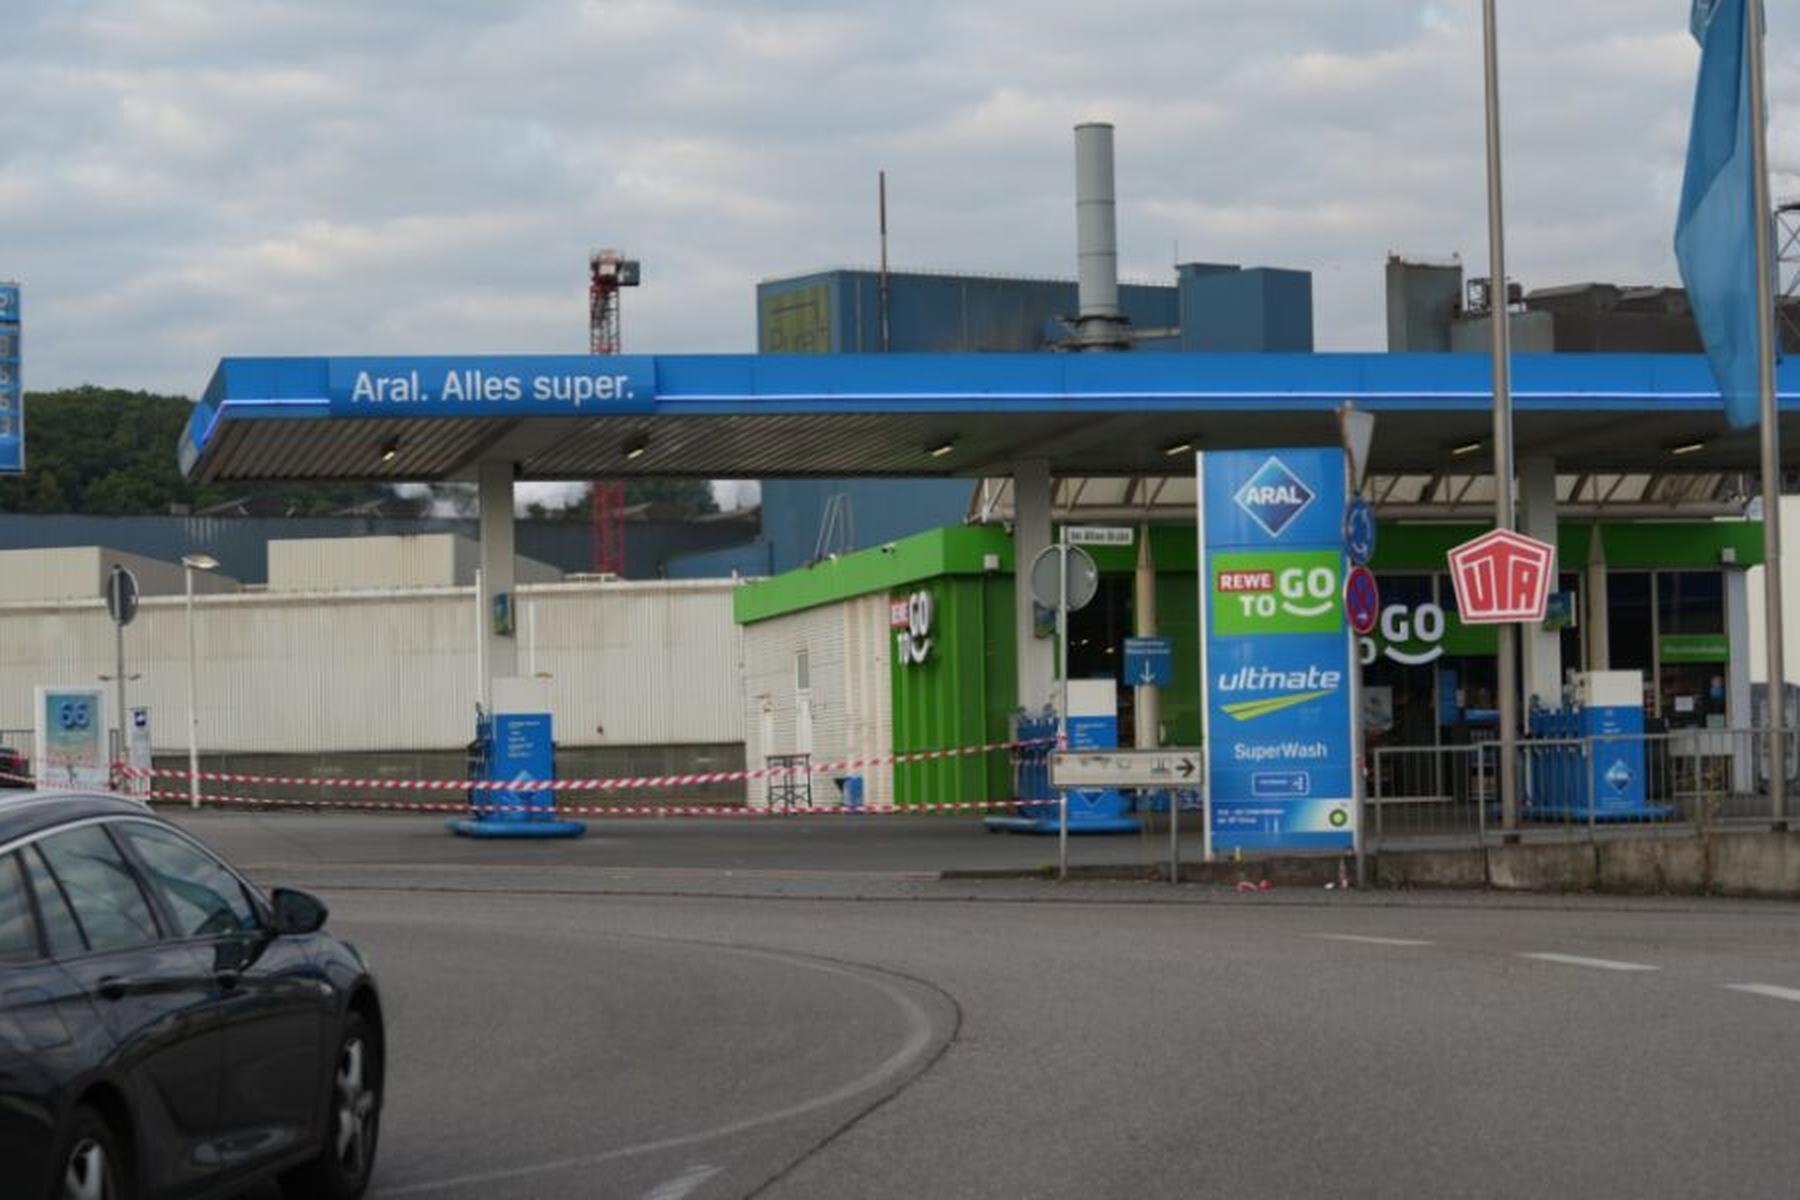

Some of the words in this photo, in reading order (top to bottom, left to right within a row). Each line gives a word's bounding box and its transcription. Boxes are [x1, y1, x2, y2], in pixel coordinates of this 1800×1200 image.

[352, 371, 428, 403] Aral.
[441, 370, 522, 401] Alles
[533, 374, 634, 407] super.
[1245, 487, 1302, 504] ARAL
[1219, 573, 1272, 590] REWE
[1281, 568, 1335, 598] GO
[1460, 540, 1543, 612] UTA
[1241, 596, 1276, 617] TO
[1382, 604, 1445, 642] GO
[1219, 665, 1341, 691] ultimate
[1233, 742, 1328, 764] SuperWash
